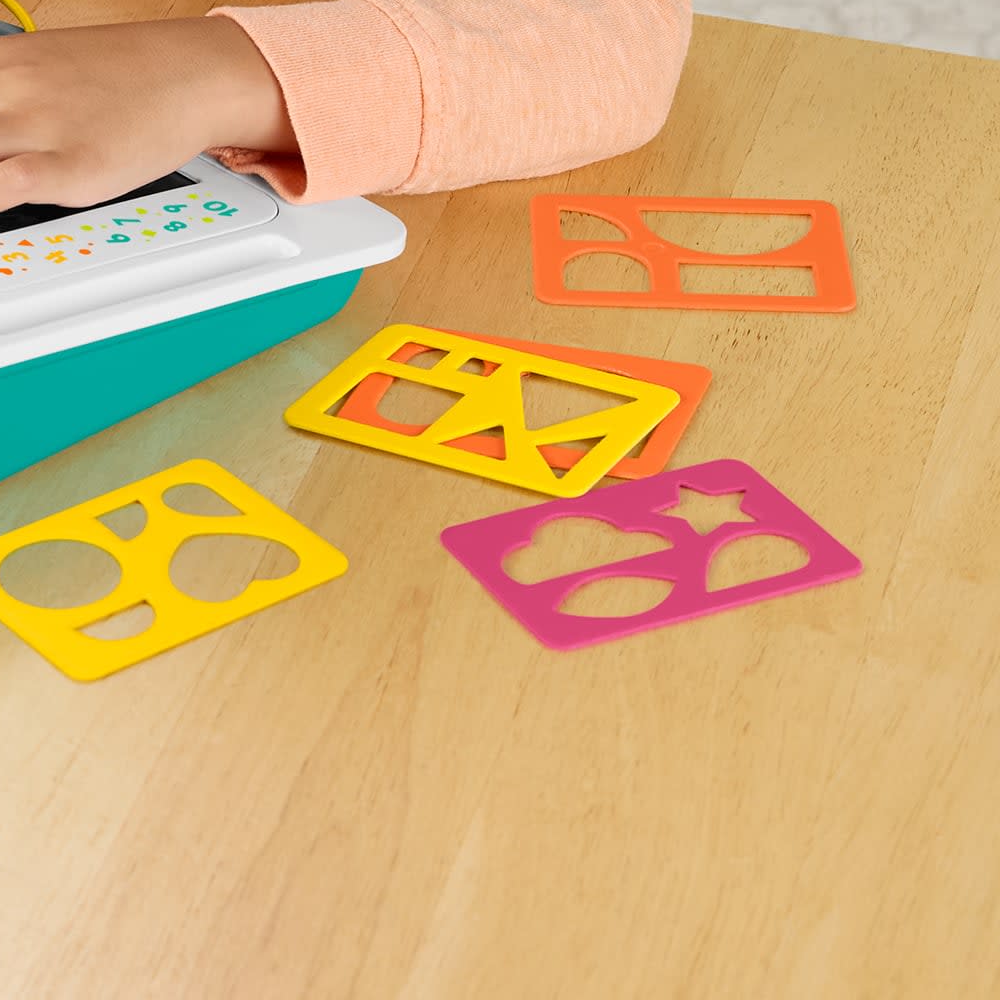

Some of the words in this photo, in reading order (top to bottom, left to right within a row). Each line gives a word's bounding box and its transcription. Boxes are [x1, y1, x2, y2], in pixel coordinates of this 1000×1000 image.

[162, 204, 187, 213] 9
[202, 201, 238, 217] 10
[112, 218, 141, 226] 7
[163, 220, 187, 232] 8
[45, 234, 73, 244] 5
[106, 234, 131, 244] 6
[1, 252, 30, 263] 3
[44, 250, 68, 264] 4
